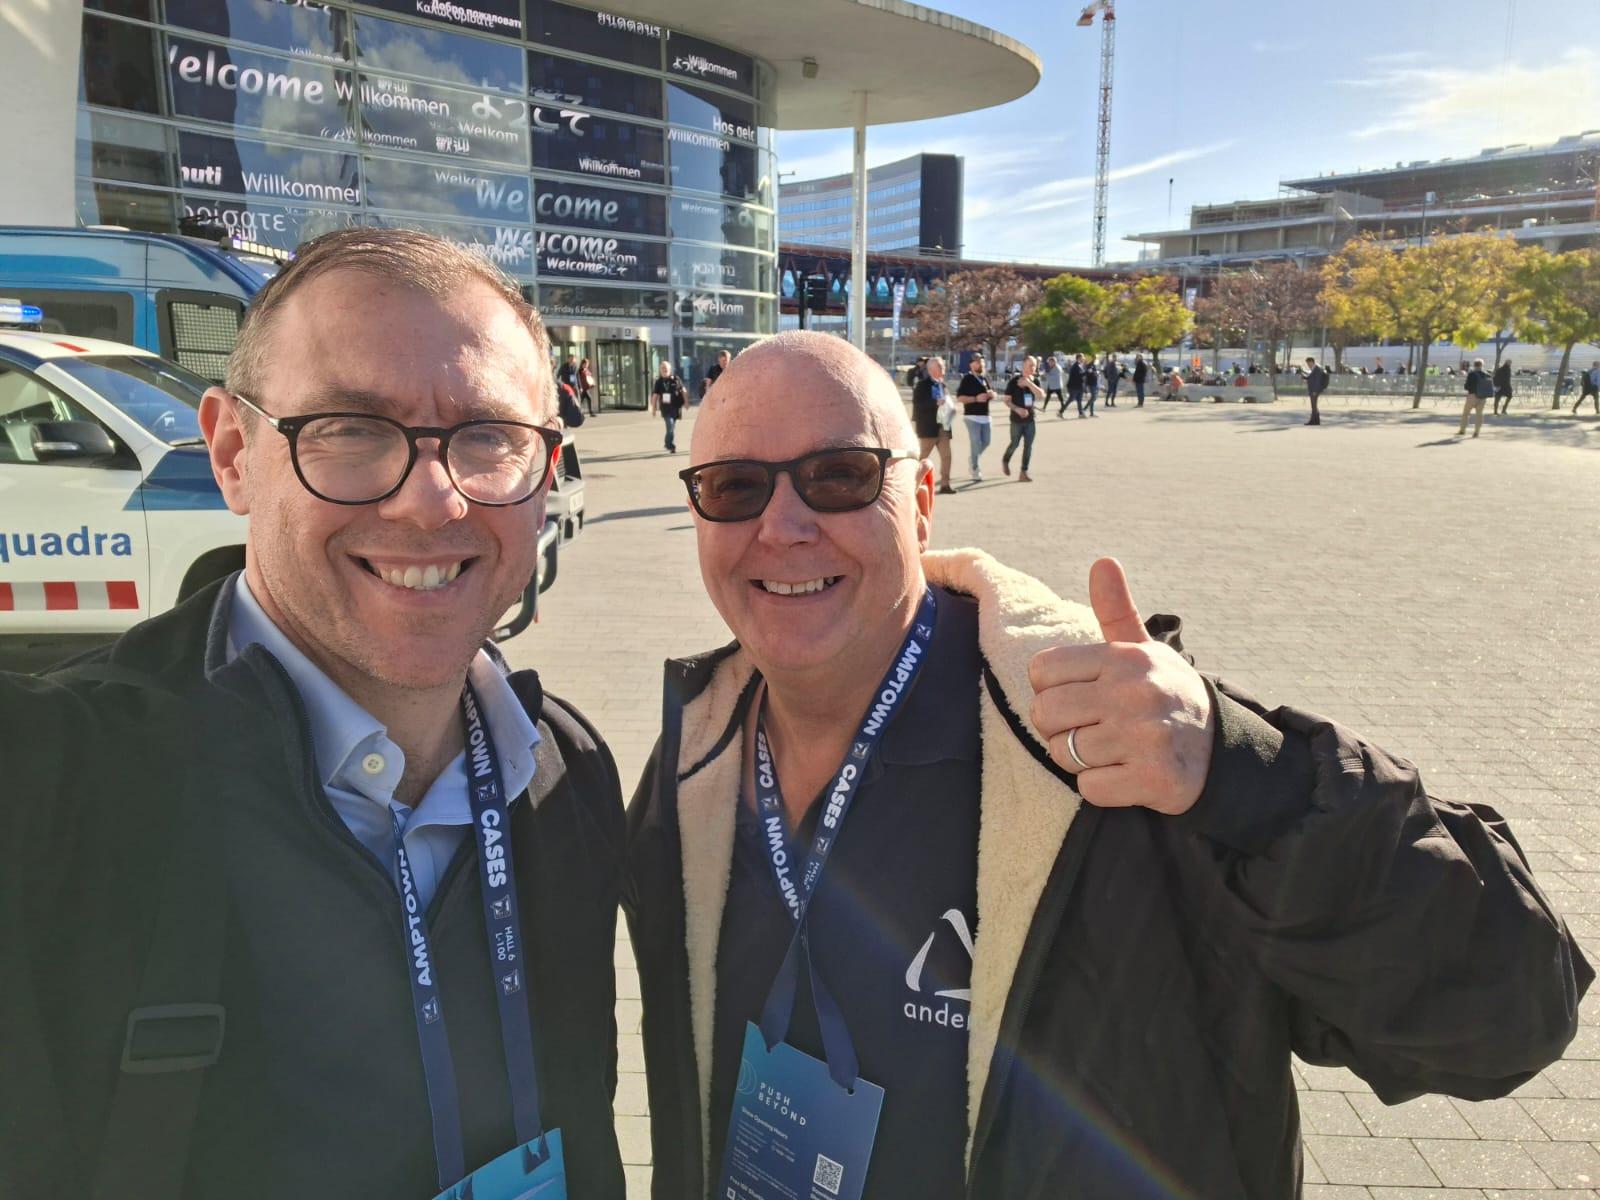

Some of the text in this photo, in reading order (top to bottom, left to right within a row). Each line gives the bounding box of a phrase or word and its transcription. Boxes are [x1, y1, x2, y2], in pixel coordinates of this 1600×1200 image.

[169, 44, 325, 105] elcome
[334, 79, 450, 116] Wllkommen
[345, 126, 418, 147] Wllkommen
[458, 121, 519, 143] Welkom
[578, 158, 641, 178] Willkommen
[475, 179, 619, 224] Wecome
[546, 256, 603, 275] Welcome
[862, 639, 922, 736] AMPTOWN
[758, 731, 774, 788] CASES
[823, 764, 857, 829] CASES
[480, 808, 506, 888] CASES
[504, 926, 517, 962] HALL 6
[758, 1092, 807, 1126] BEYOND
[760, 1082, 791, 1106] PUSH
